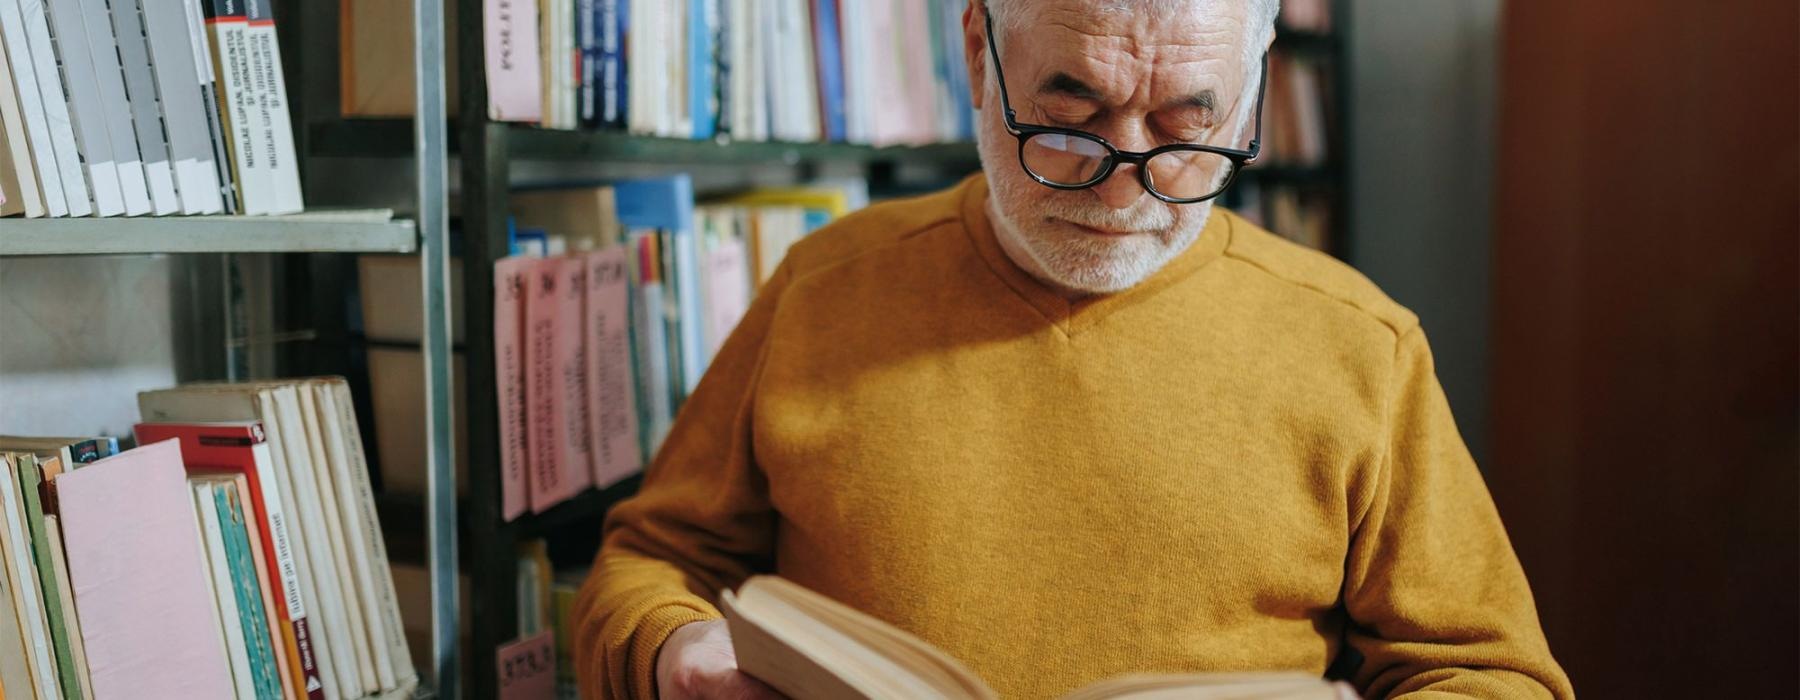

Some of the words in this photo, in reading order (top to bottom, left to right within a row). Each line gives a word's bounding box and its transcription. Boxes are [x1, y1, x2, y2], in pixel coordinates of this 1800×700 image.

[226, 30, 241, 87] DISIDENTUL
[236, 30, 252, 93] JURNALISTUL
[241, 128, 254, 168] NICOLAE
